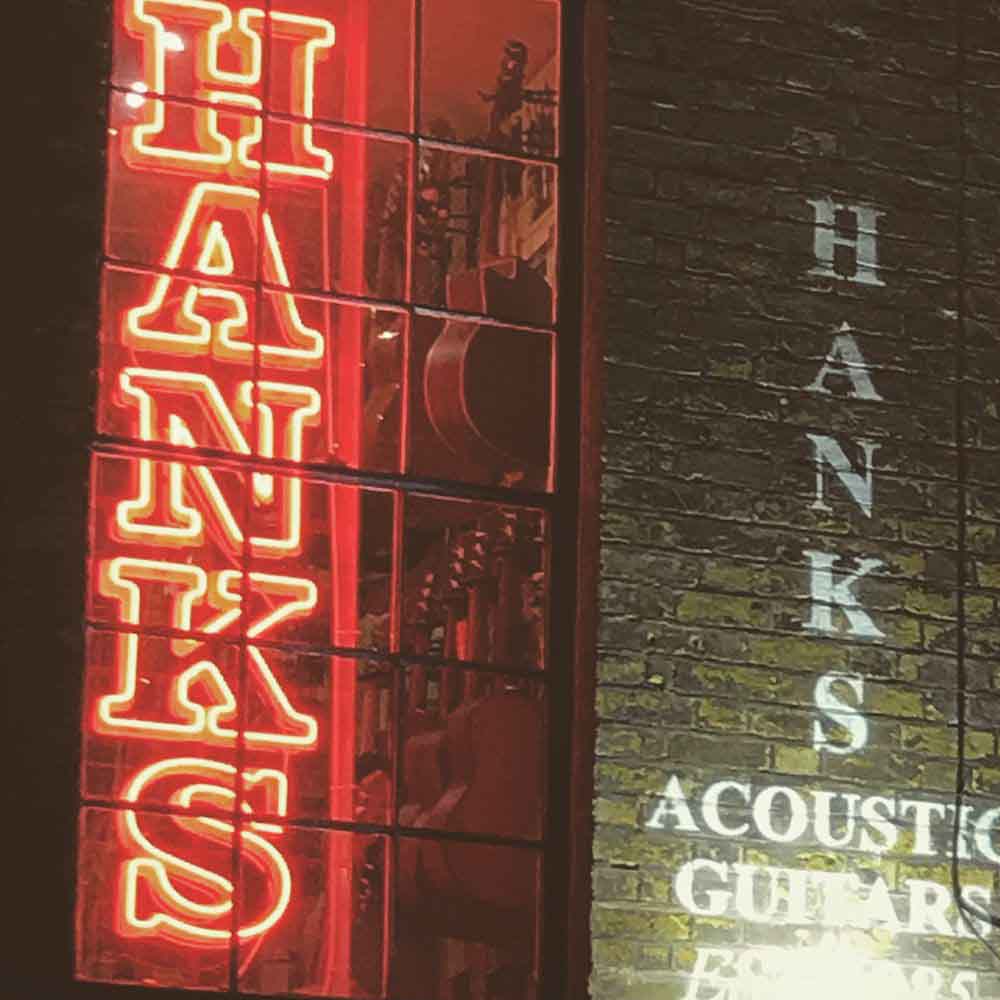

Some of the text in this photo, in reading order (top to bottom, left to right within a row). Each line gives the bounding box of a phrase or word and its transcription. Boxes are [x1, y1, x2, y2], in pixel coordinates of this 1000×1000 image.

[95, 0, 336, 942] HANKS
[806, 197, 886, 755] HANKS
[675, 859, 992, 937] GUITARS
